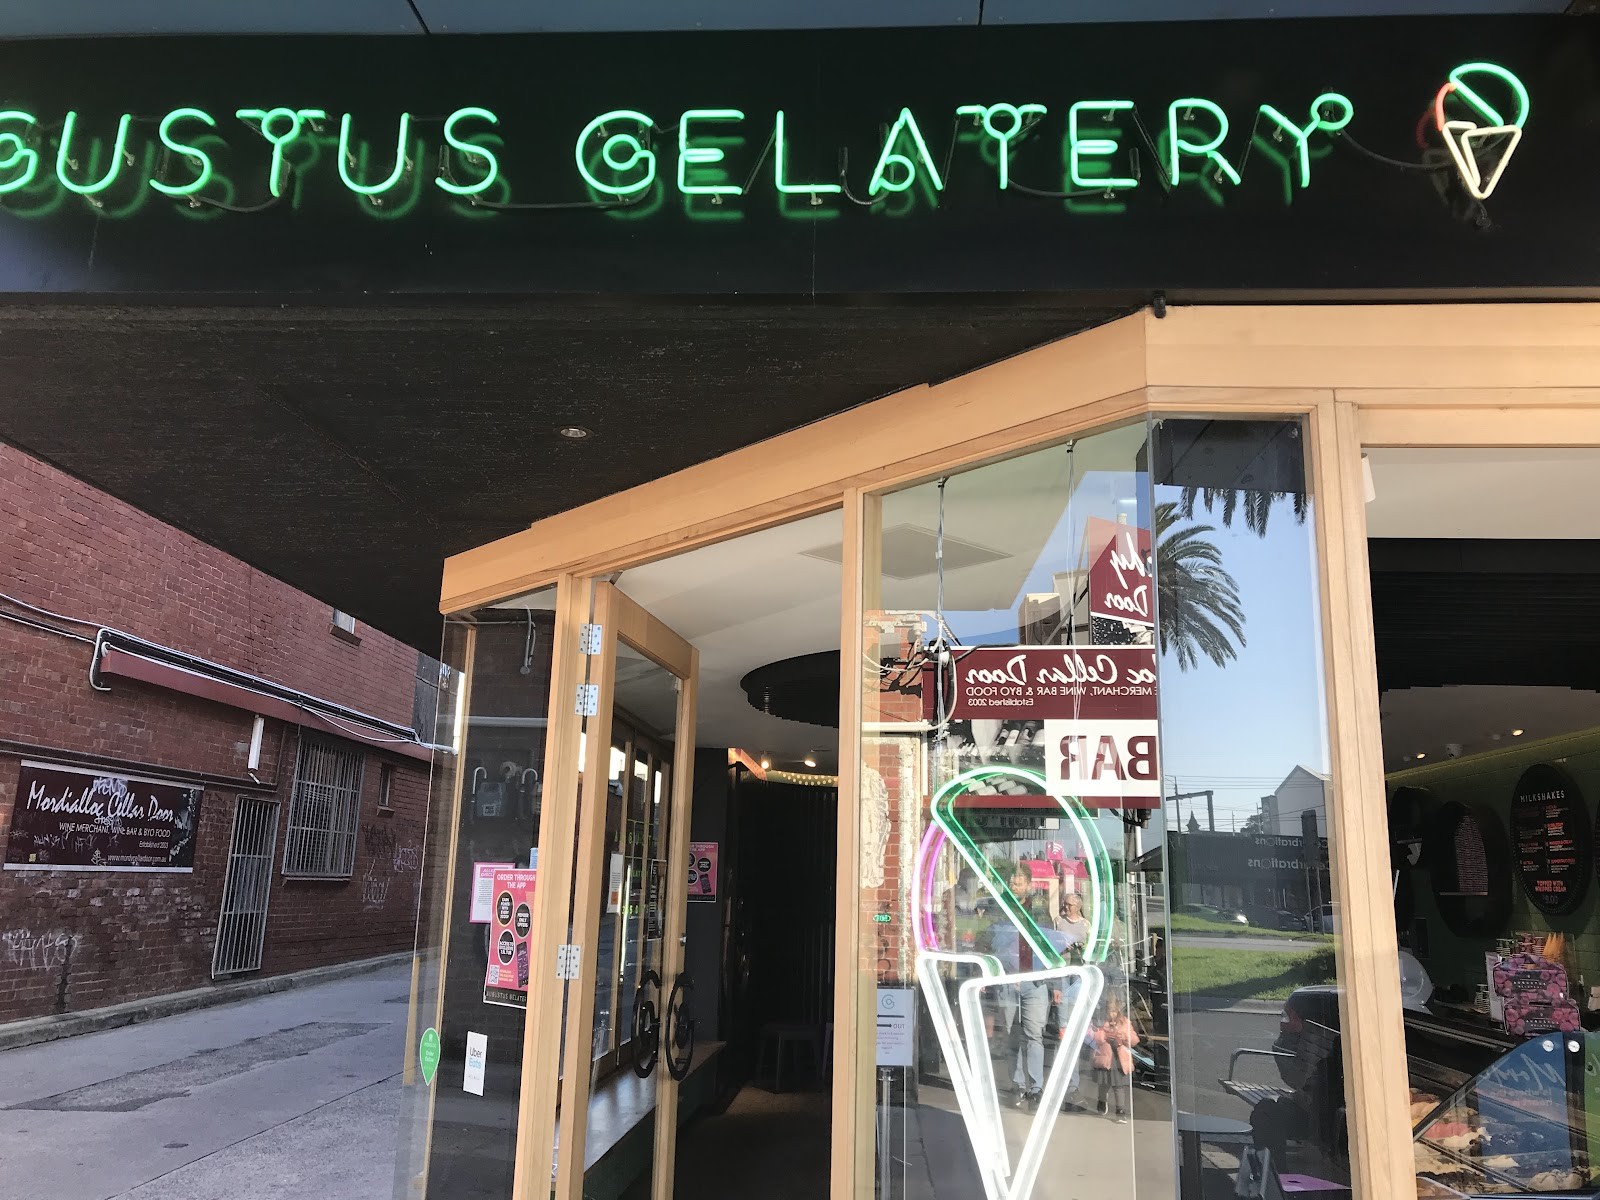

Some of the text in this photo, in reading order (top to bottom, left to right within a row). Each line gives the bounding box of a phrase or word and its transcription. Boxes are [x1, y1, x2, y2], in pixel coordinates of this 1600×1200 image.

[575, 92, 1355, 196] GELATERY
[26, 780, 104, 817] Mordialloc
[108, 791, 144, 820] Cellar
[148, 795, 173, 823] Door
[1520, 790, 1565, 802] MILKSHAKES
[59, 822, 75, 831] WINE
[126, 827, 137, 836] BAR
[137, 828, 143, 836] &
[143, 828, 155, 837] BYO
[155, 829, 171, 838] FOOD
[496, 873, 513, 881] ORDER
[507, 881, 517, 889] THE
[469, 1047, 483, 1058] Uber
[468, 1057, 482, 1070] Eats
